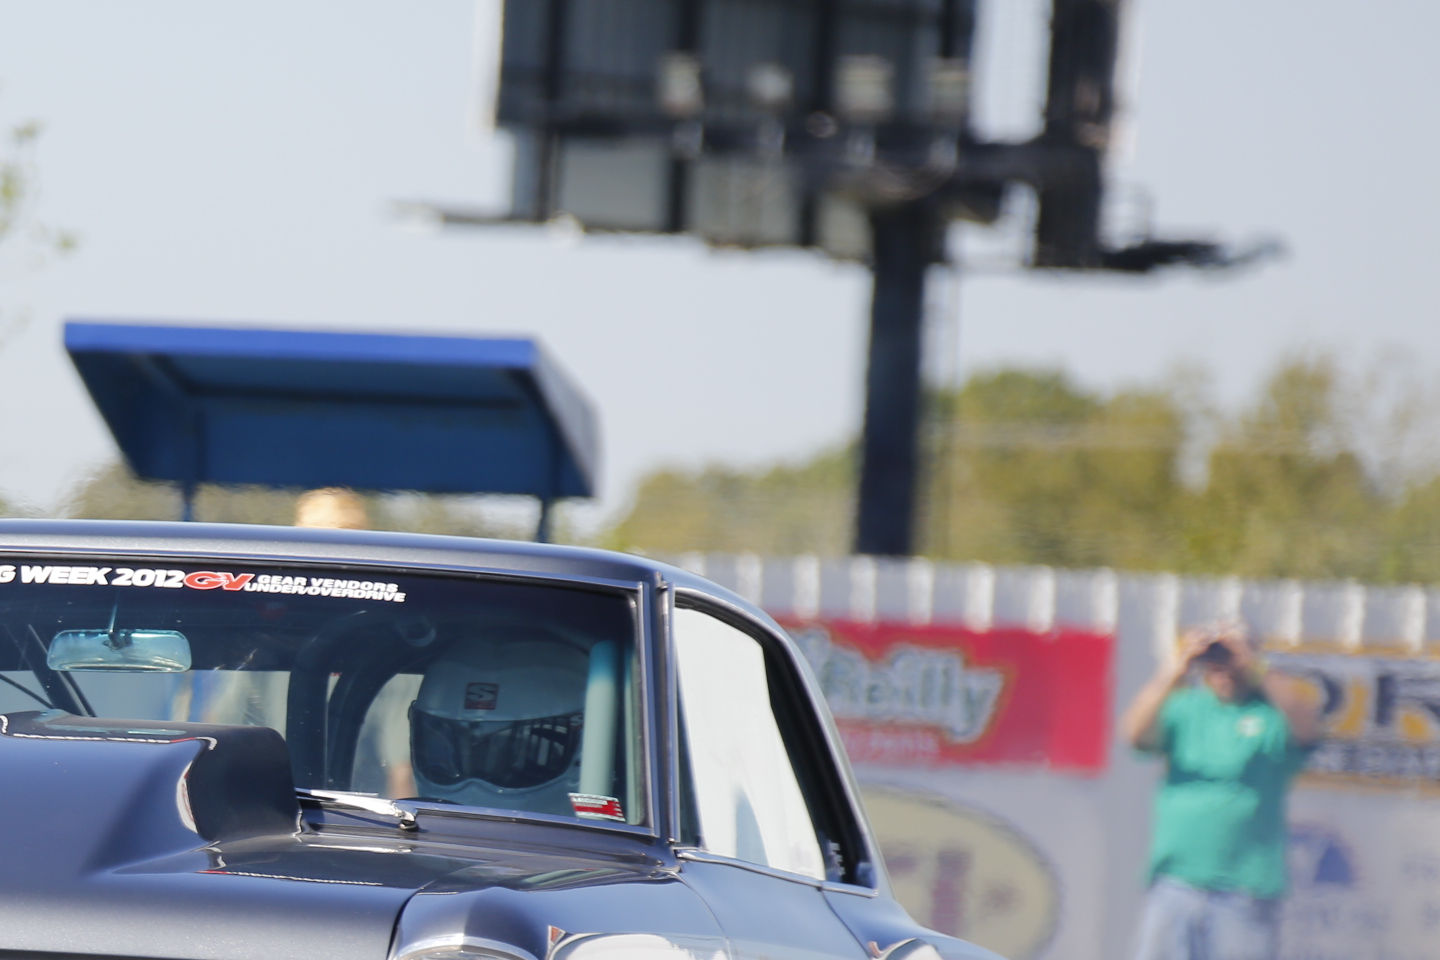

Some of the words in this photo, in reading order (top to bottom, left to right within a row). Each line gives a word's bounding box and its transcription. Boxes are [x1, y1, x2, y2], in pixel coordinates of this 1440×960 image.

[20, 565, 114, 586] WEEK
[111, 567, 187, 589] 2012
[257, 575, 307, 587] GEAR
[310, 577, 399, 593] VENDORS
